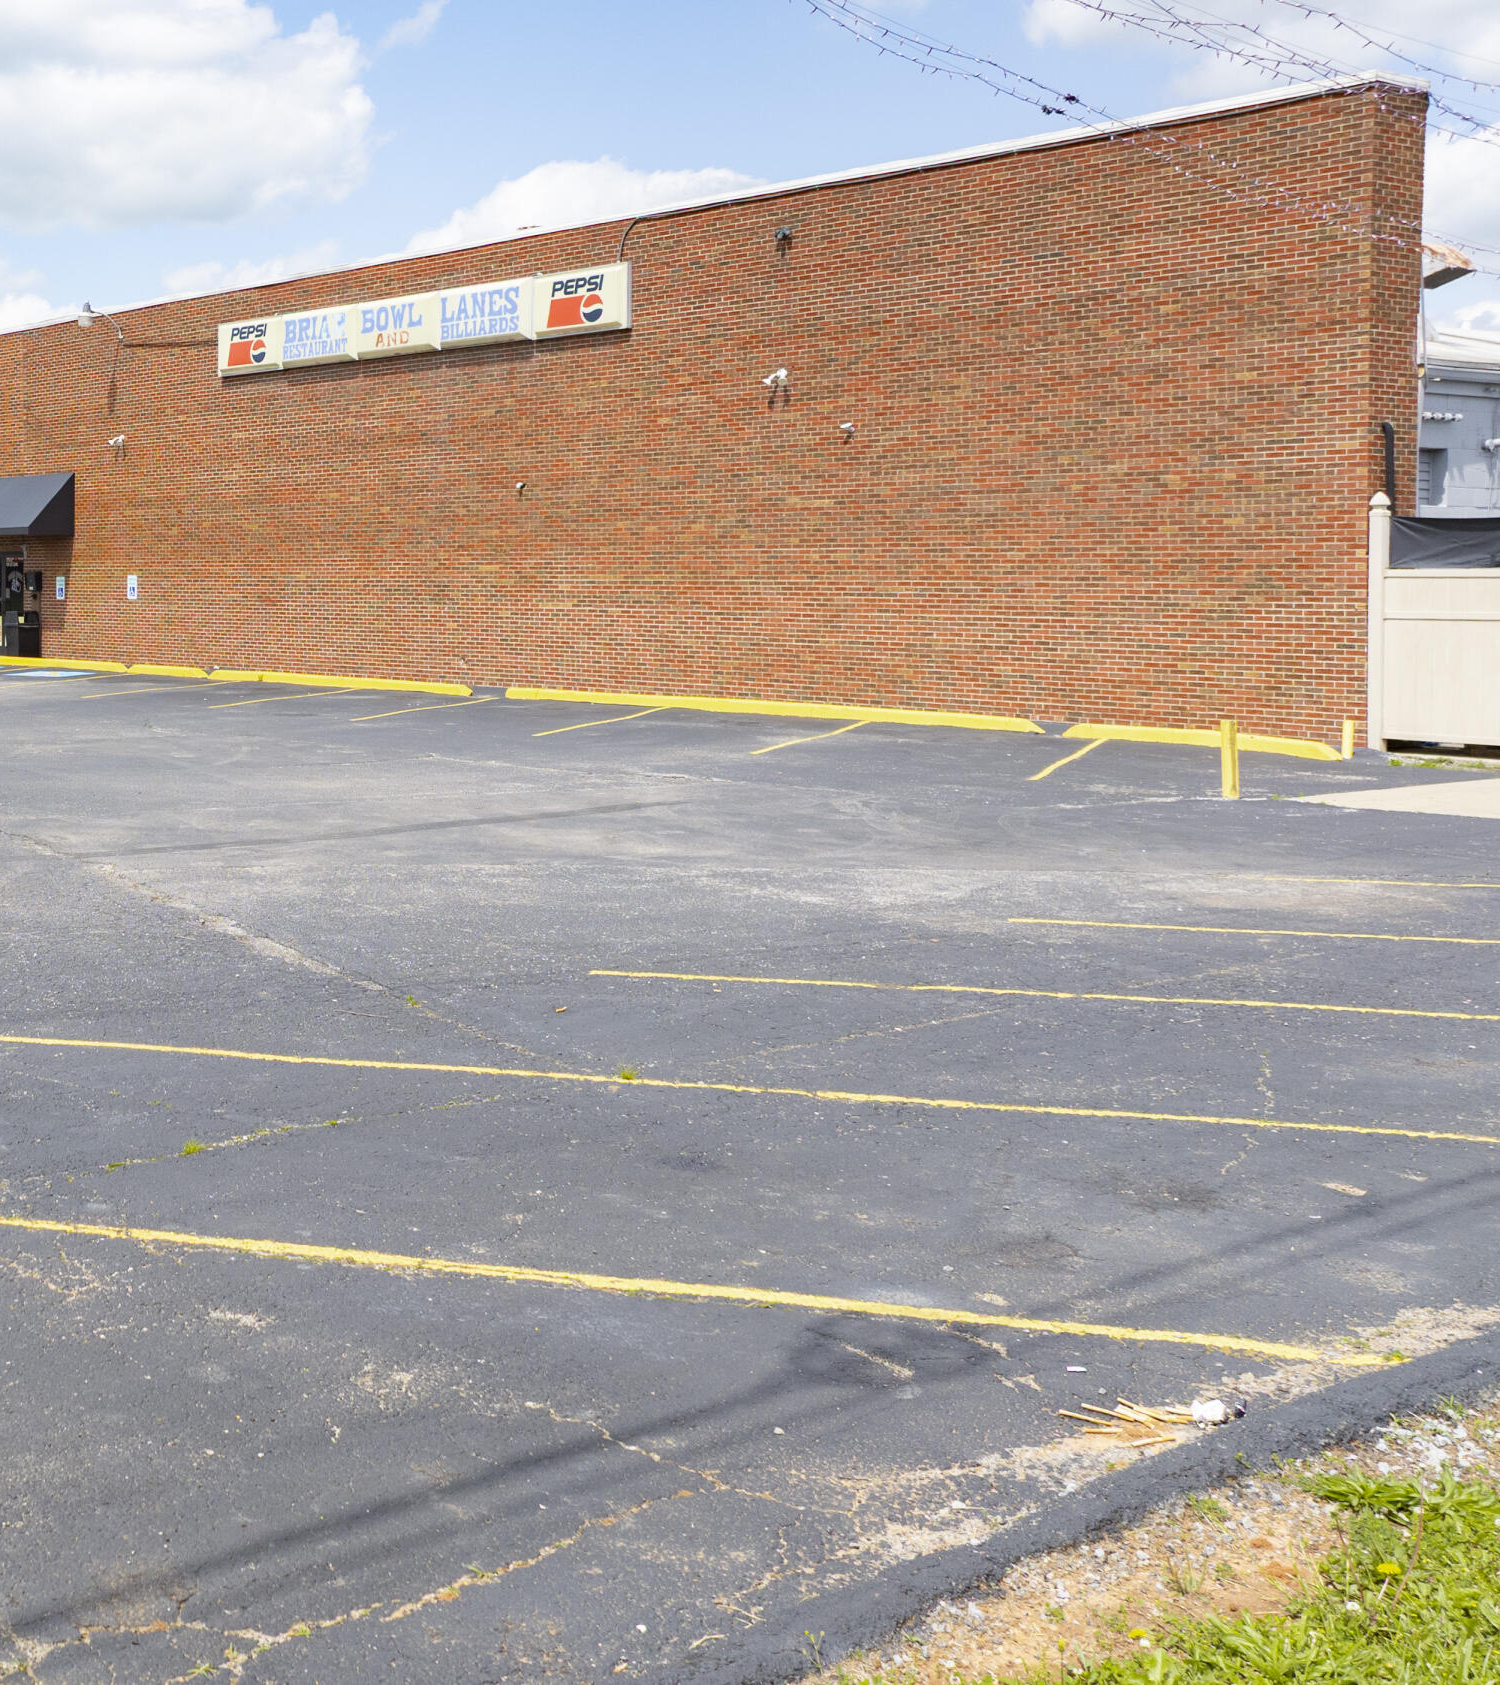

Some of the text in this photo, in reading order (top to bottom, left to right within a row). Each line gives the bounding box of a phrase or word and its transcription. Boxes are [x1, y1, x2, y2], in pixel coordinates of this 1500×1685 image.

[551, 274, 605, 298] PEPSI
[360, 302, 423, 334] BOWL
[440, 286, 520, 324] LANES
[230, 323, 267, 342] PEPSI
[282, 315, 520, 360] RESTAURANT AND BILLIARDS
